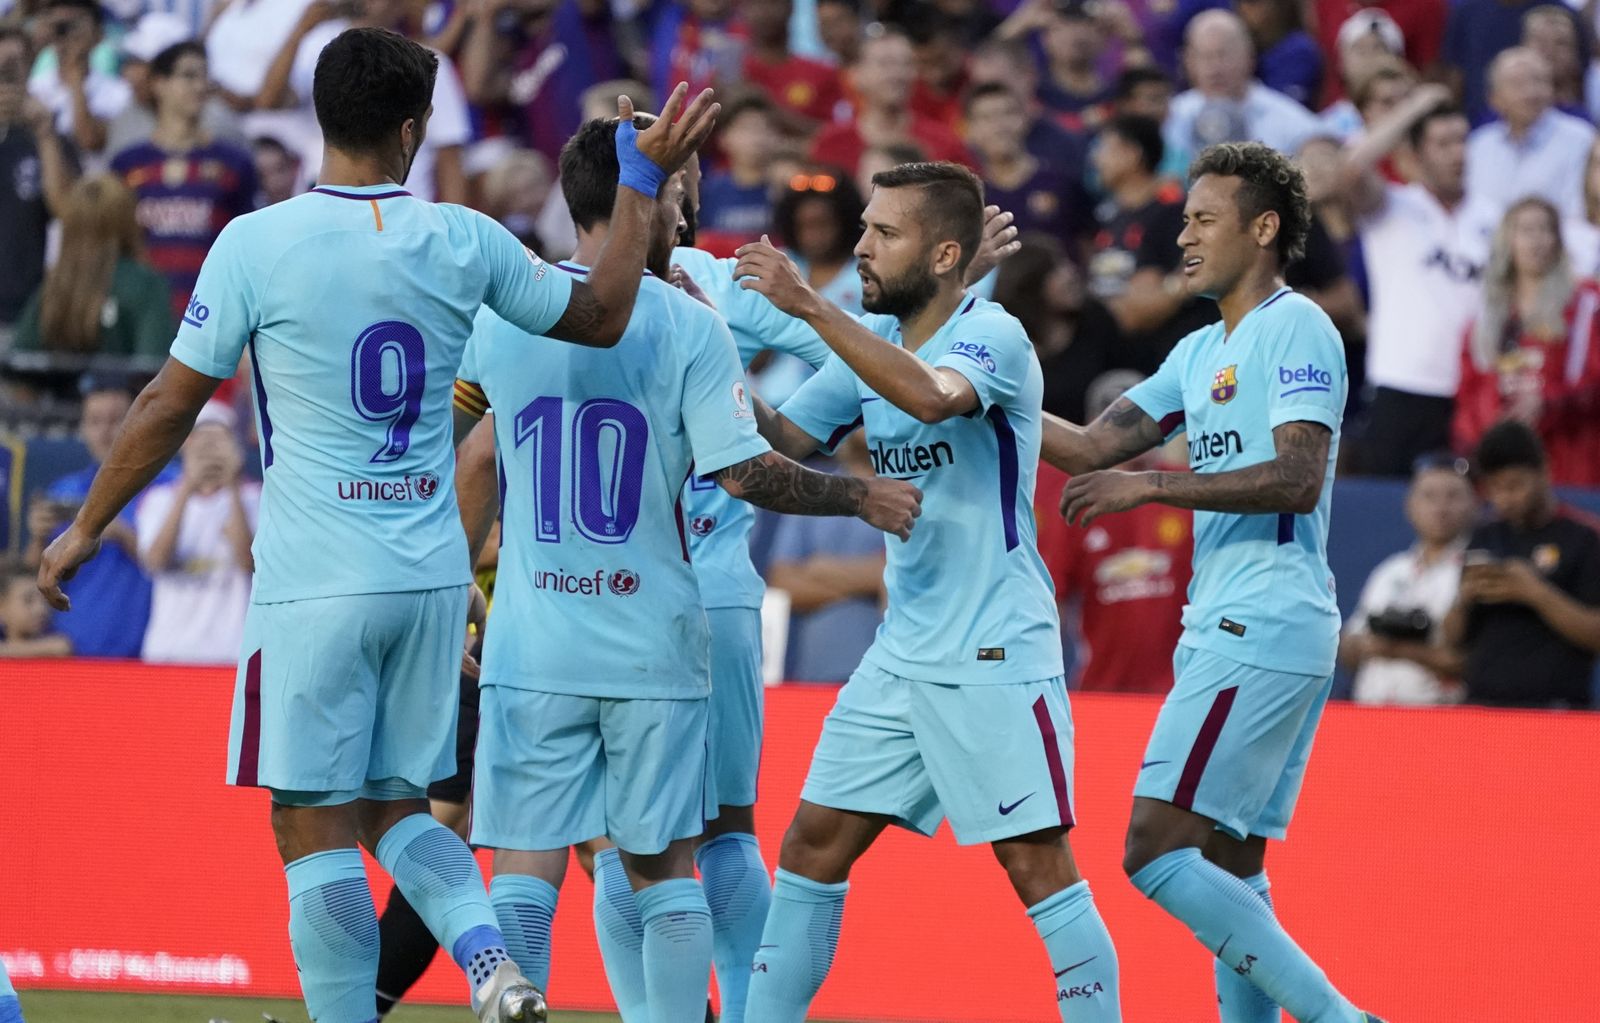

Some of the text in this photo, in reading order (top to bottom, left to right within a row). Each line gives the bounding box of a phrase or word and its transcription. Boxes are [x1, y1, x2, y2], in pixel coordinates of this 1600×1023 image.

[950, 341, 997, 374] beko
[1279, 364, 1332, 386] beko
[351, 320, 426, 463] 9
[514, 396, 649, 544] 10
[338, 475, 413, 501] unicef
[534, 568, 605, 596] unicef
[1056, 981, 1104, 1002] ARÇA
